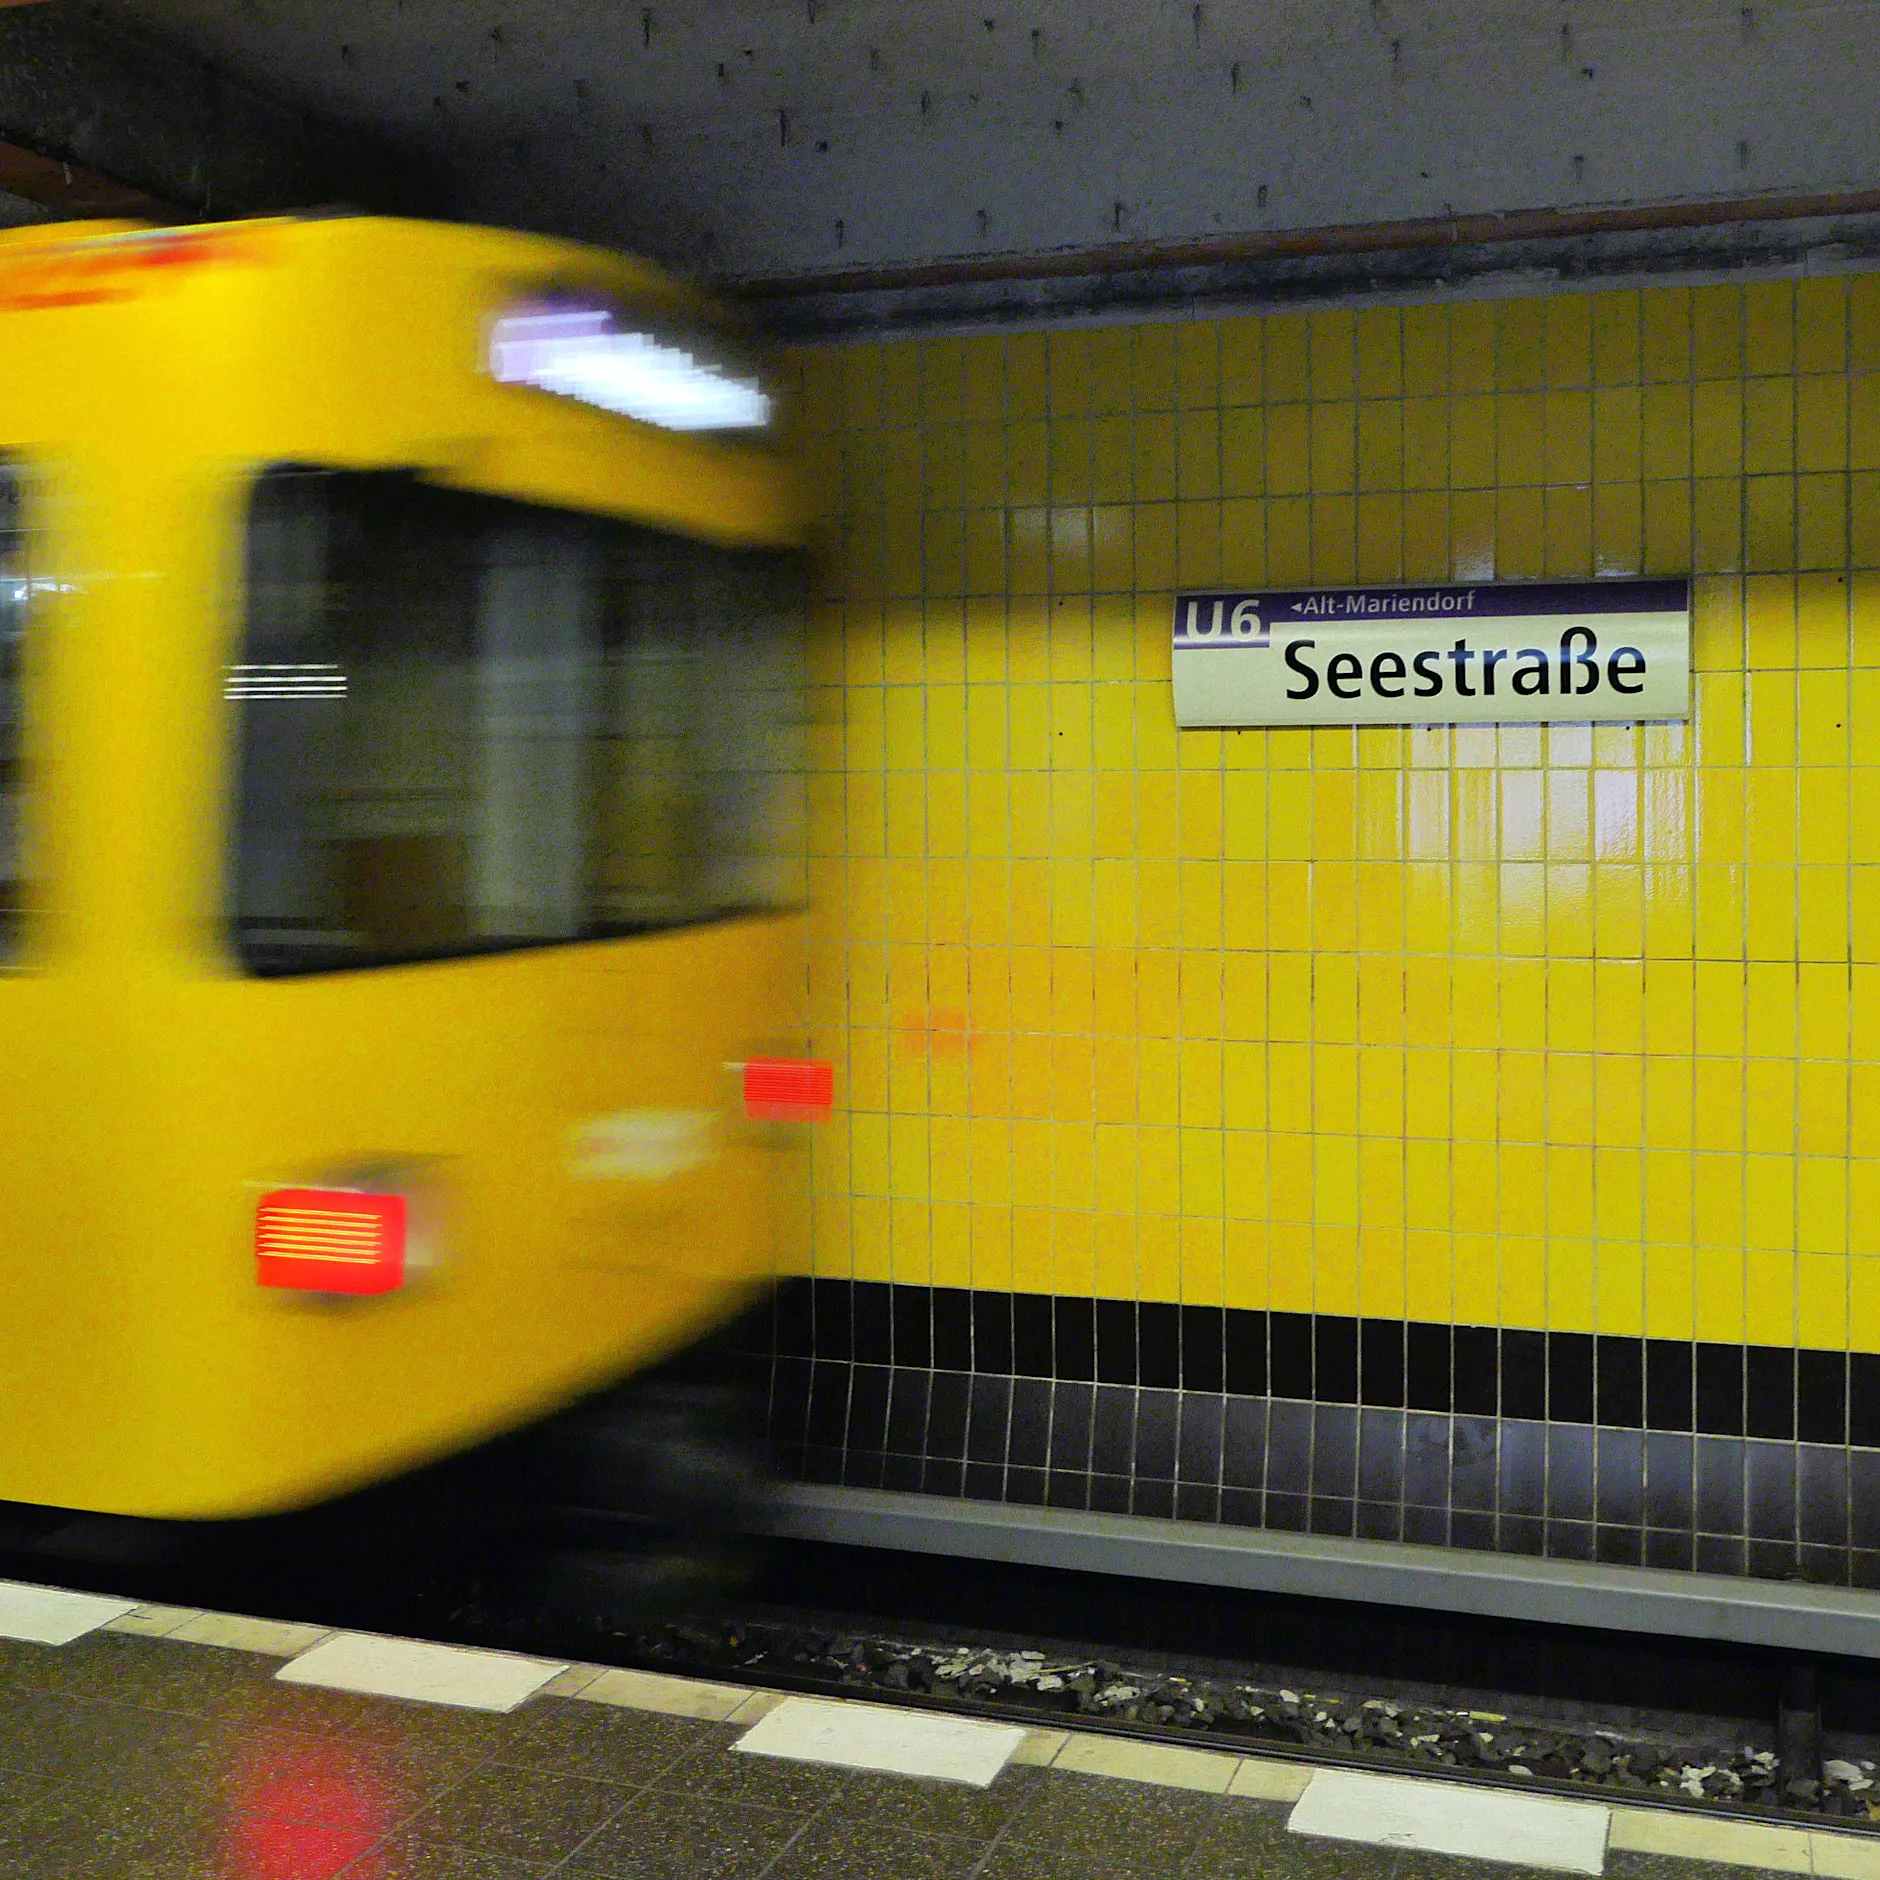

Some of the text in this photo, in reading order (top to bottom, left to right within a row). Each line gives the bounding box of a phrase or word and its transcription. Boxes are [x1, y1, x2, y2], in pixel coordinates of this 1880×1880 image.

[1185, 598, 1263, 643] U6
[1303, 589, 1477, 615] Alt-Mariendorf
[1283, 626, 1647, 700] Seestraße
